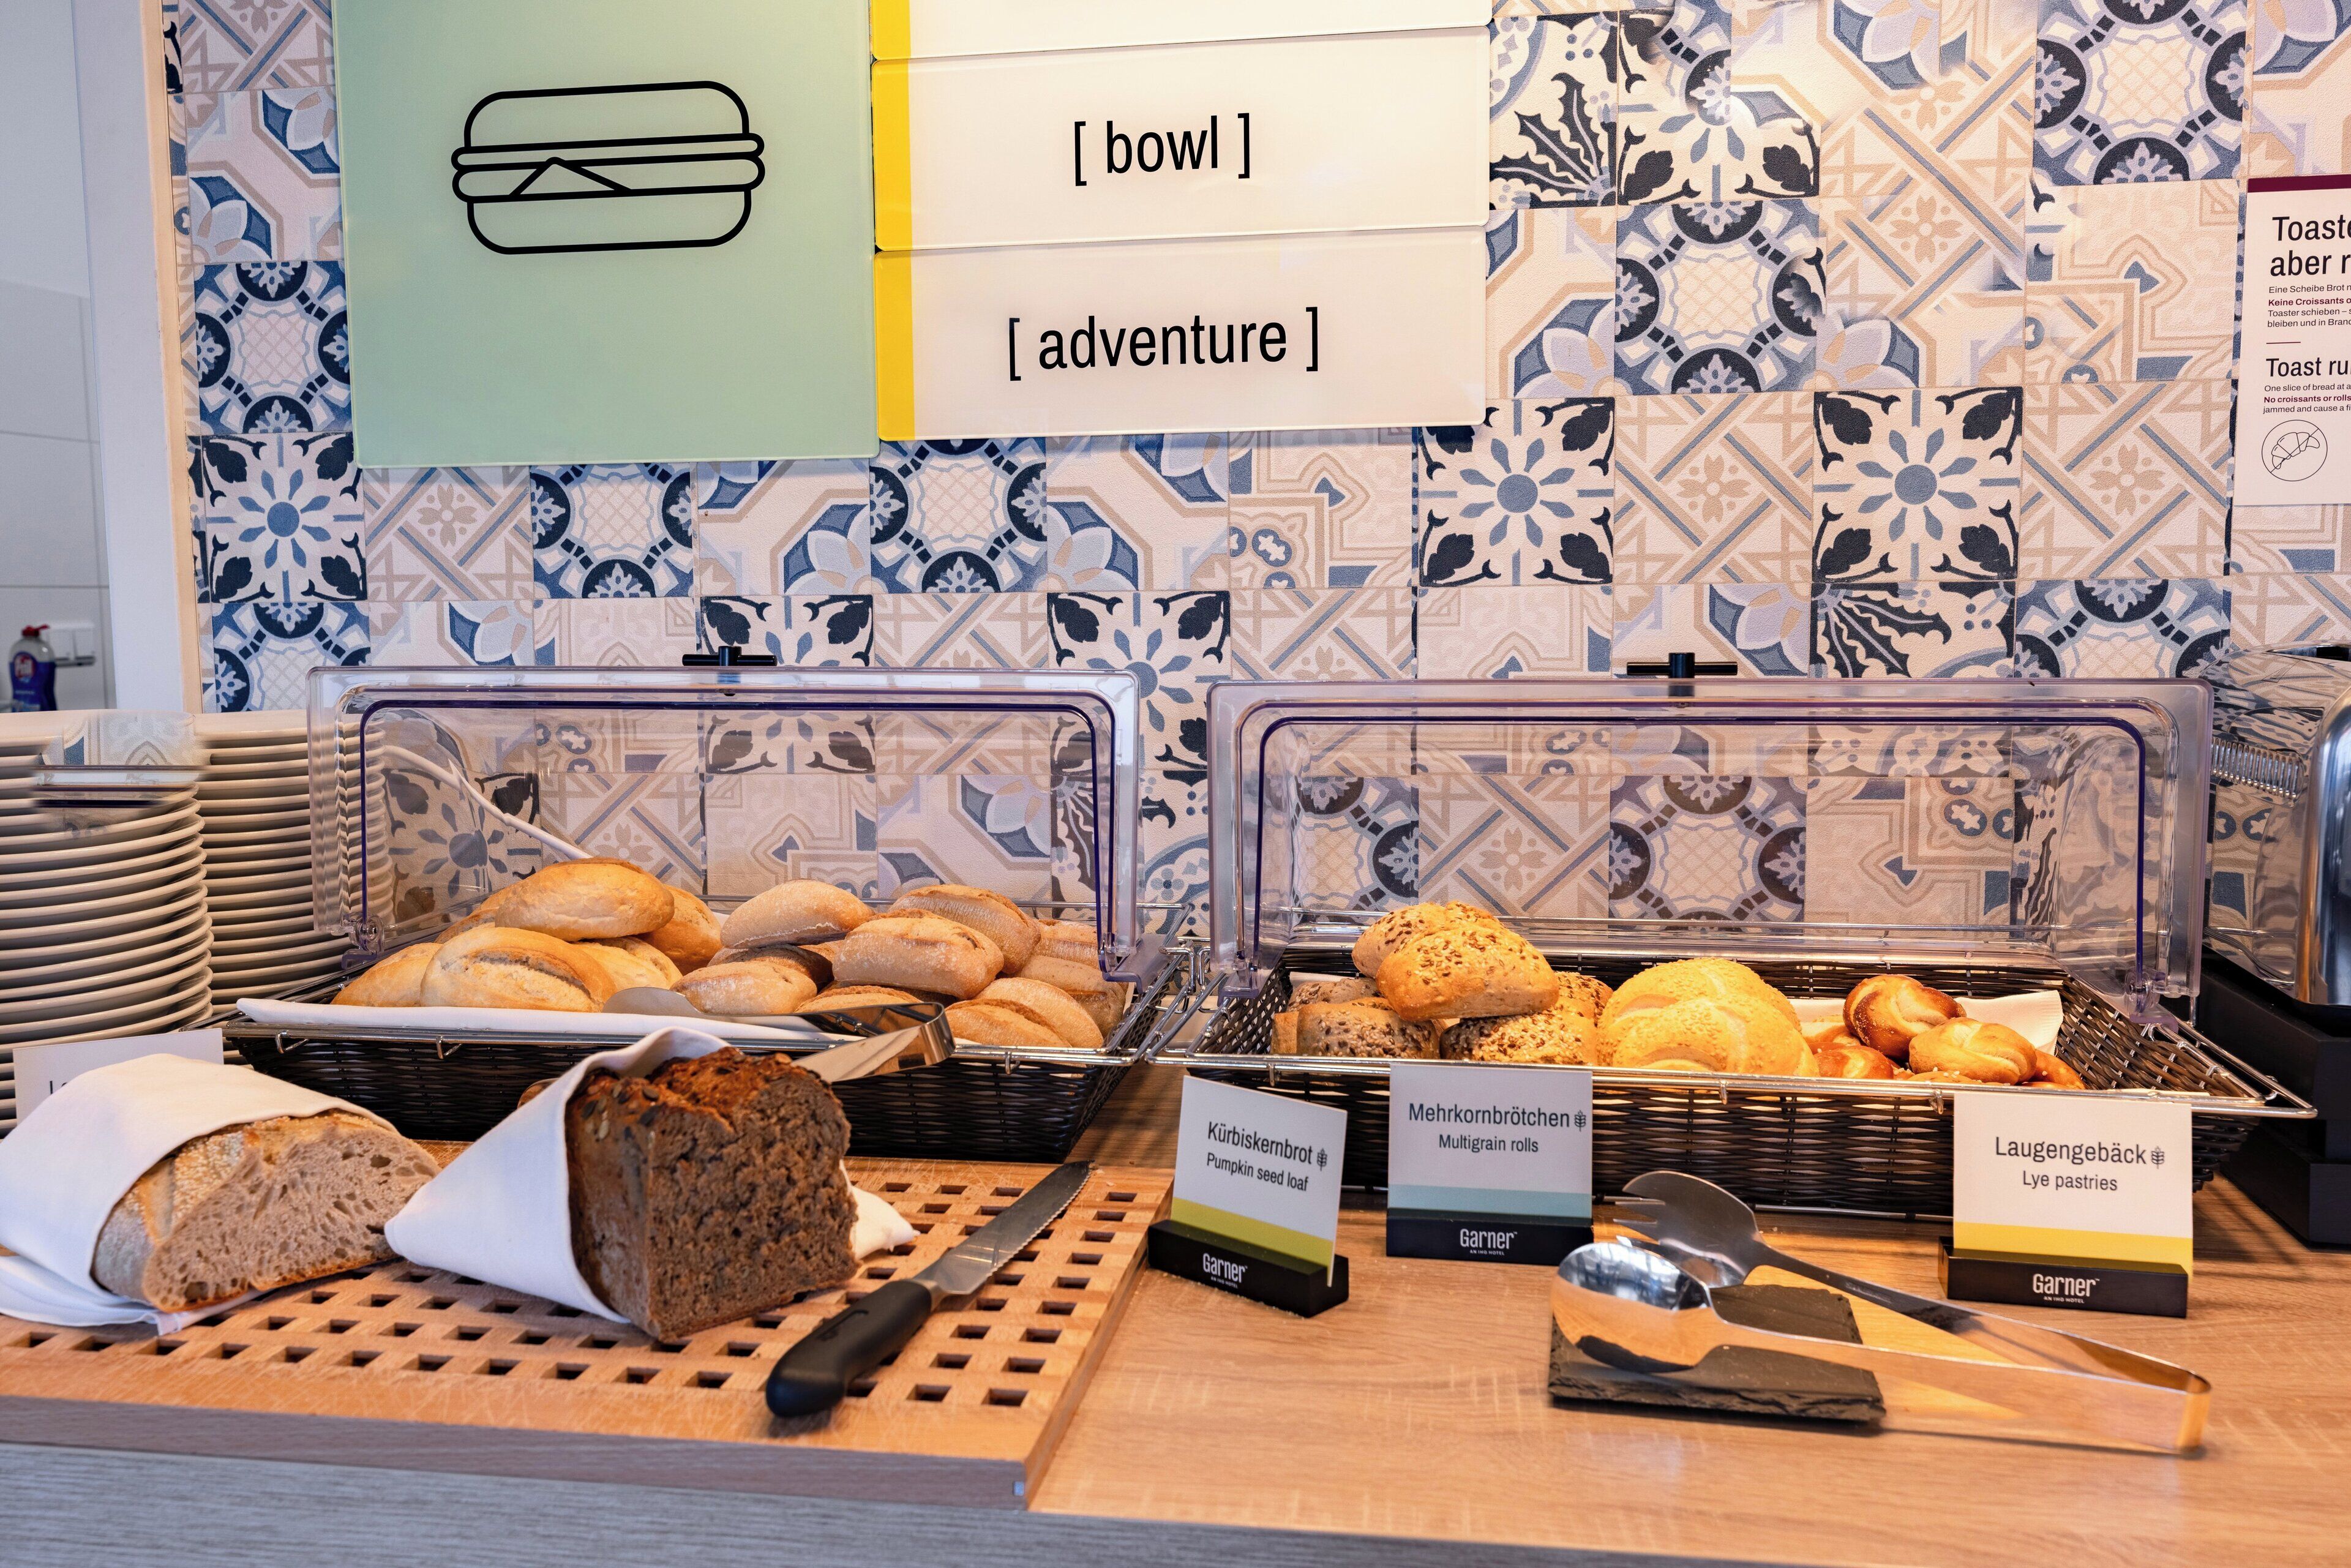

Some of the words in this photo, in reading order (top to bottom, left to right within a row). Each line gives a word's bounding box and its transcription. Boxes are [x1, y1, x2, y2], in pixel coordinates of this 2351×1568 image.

[1106, 115, 1218, 174] bowl
[2272, 214, 2351, 241] Toast
[2270, 250, 2332, 277] aber
[2290, 284, 2325, 293] Scheibe
[2295, 297, 2344, 306] Croissants
[1039, 315, 1286, 370] adventure
[2265, 357, 2322, 377] Toast
[2263, 406, 2295, 415] jammed
[1409, 1103, 1570, 1128] Mehrkornbrötchen
[1208, 1121, 1313, 1165] Kürbiskernbrot
[1439, 1134, 1506, 1153] Multigrain
[1510, 1137, 1539, 1153] rolls
[1995, 1136, 2147, 1165] Laugengebäck
[1207, 1152, 1254, 1178] Pumpkin
[1257, 1167, 1284, 1185] seed
[1287, 1171, 1310, 1191] loaf
[2023, 1170, 2049, 1190] Lye
[2055, 1174, 2118, 1191] pastries
